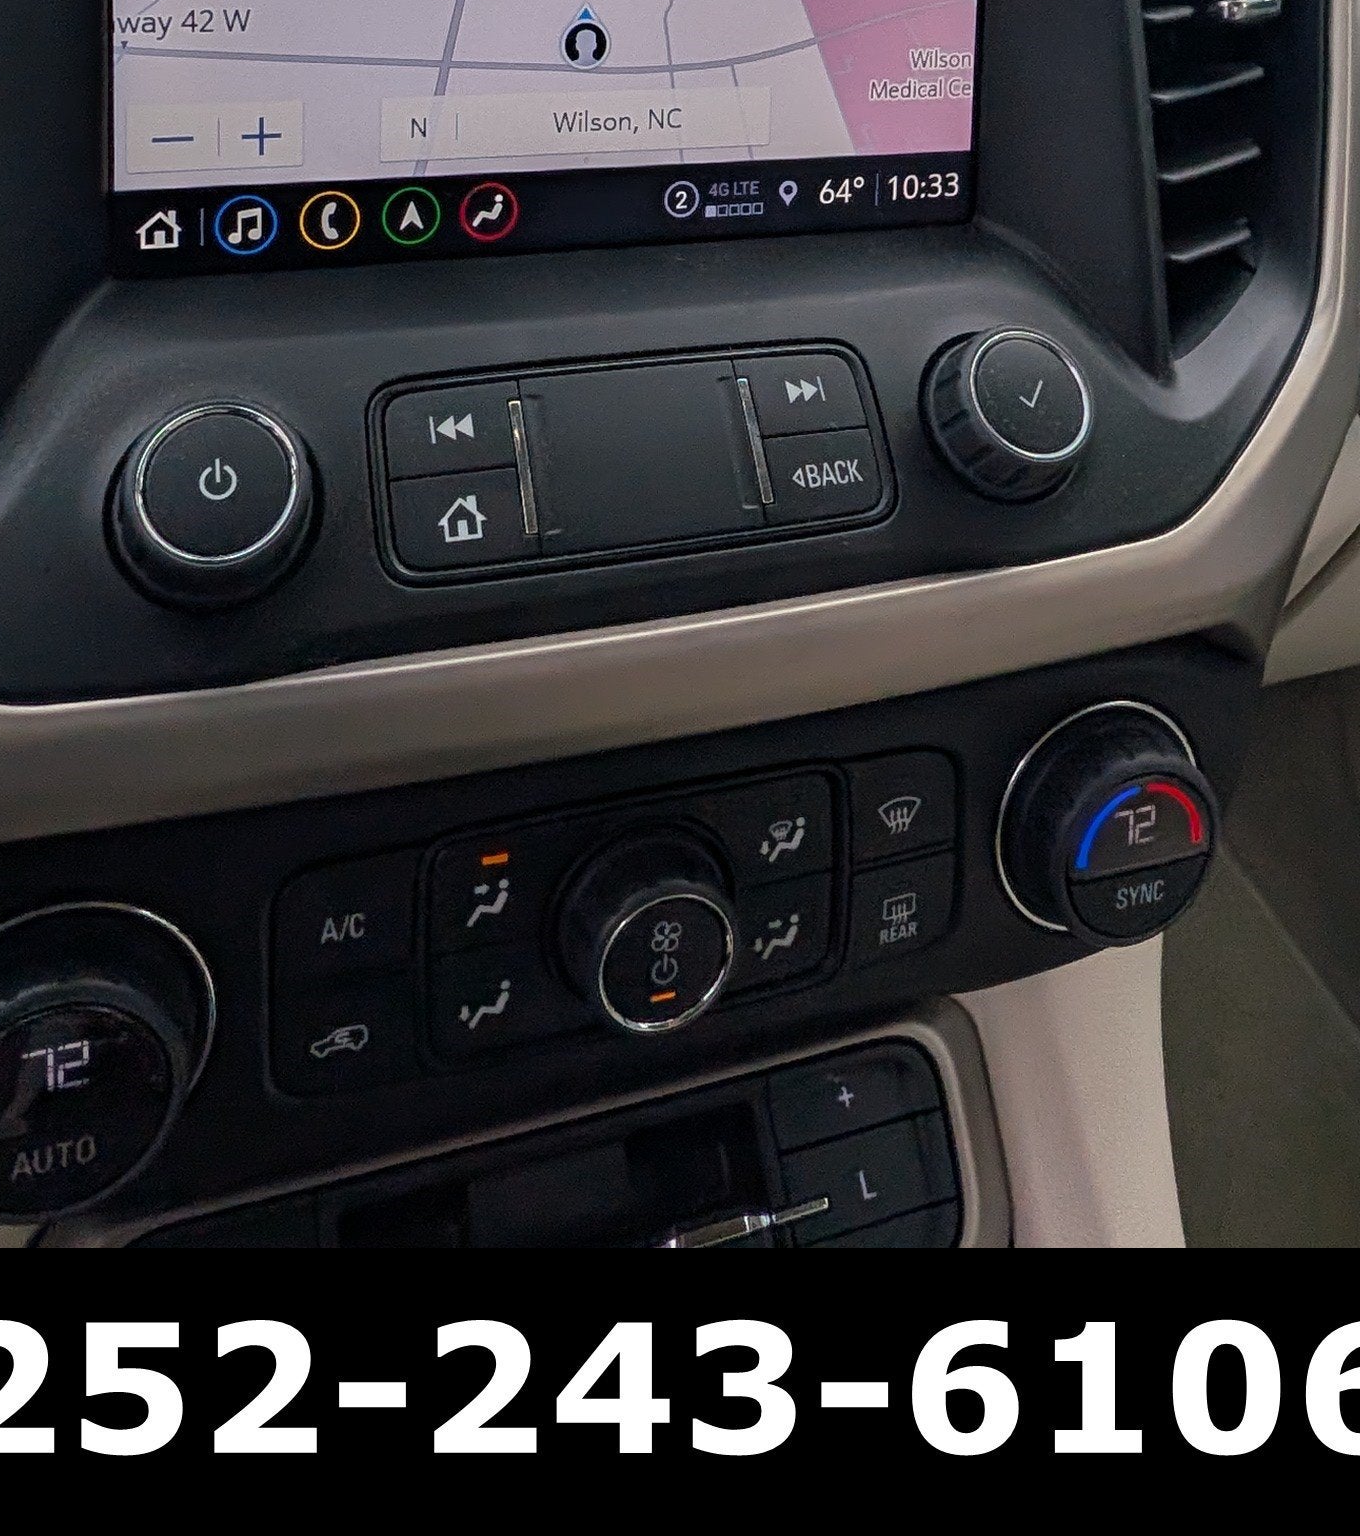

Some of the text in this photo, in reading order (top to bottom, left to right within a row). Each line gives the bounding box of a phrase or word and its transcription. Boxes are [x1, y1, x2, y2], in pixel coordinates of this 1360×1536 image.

[180, 9, 215, 33] 42
[222, 8, 252, 33] W
[910, 49, 972, 69] Wilson
[869, 78, 972, 99] Medical Ce
[409, 117, 428, 139] N
[553, 108, 683, 136] Wilson, NC
[674, 172, 960, 210] 2 4G LTE 64° 10:33
[805, 458, 864, 489] BACK
[1114, 804, 1157, 846] 72
[1114, 879, 1166, 911] SYNC
[319, 911, 366, 946] A/C
[878, 921, 919, 946] REAR
[21, 1039, 91, 1094] 72
[10, 1133, 97, 1184] AUTO
[858, 1169, 878, 1201] L
